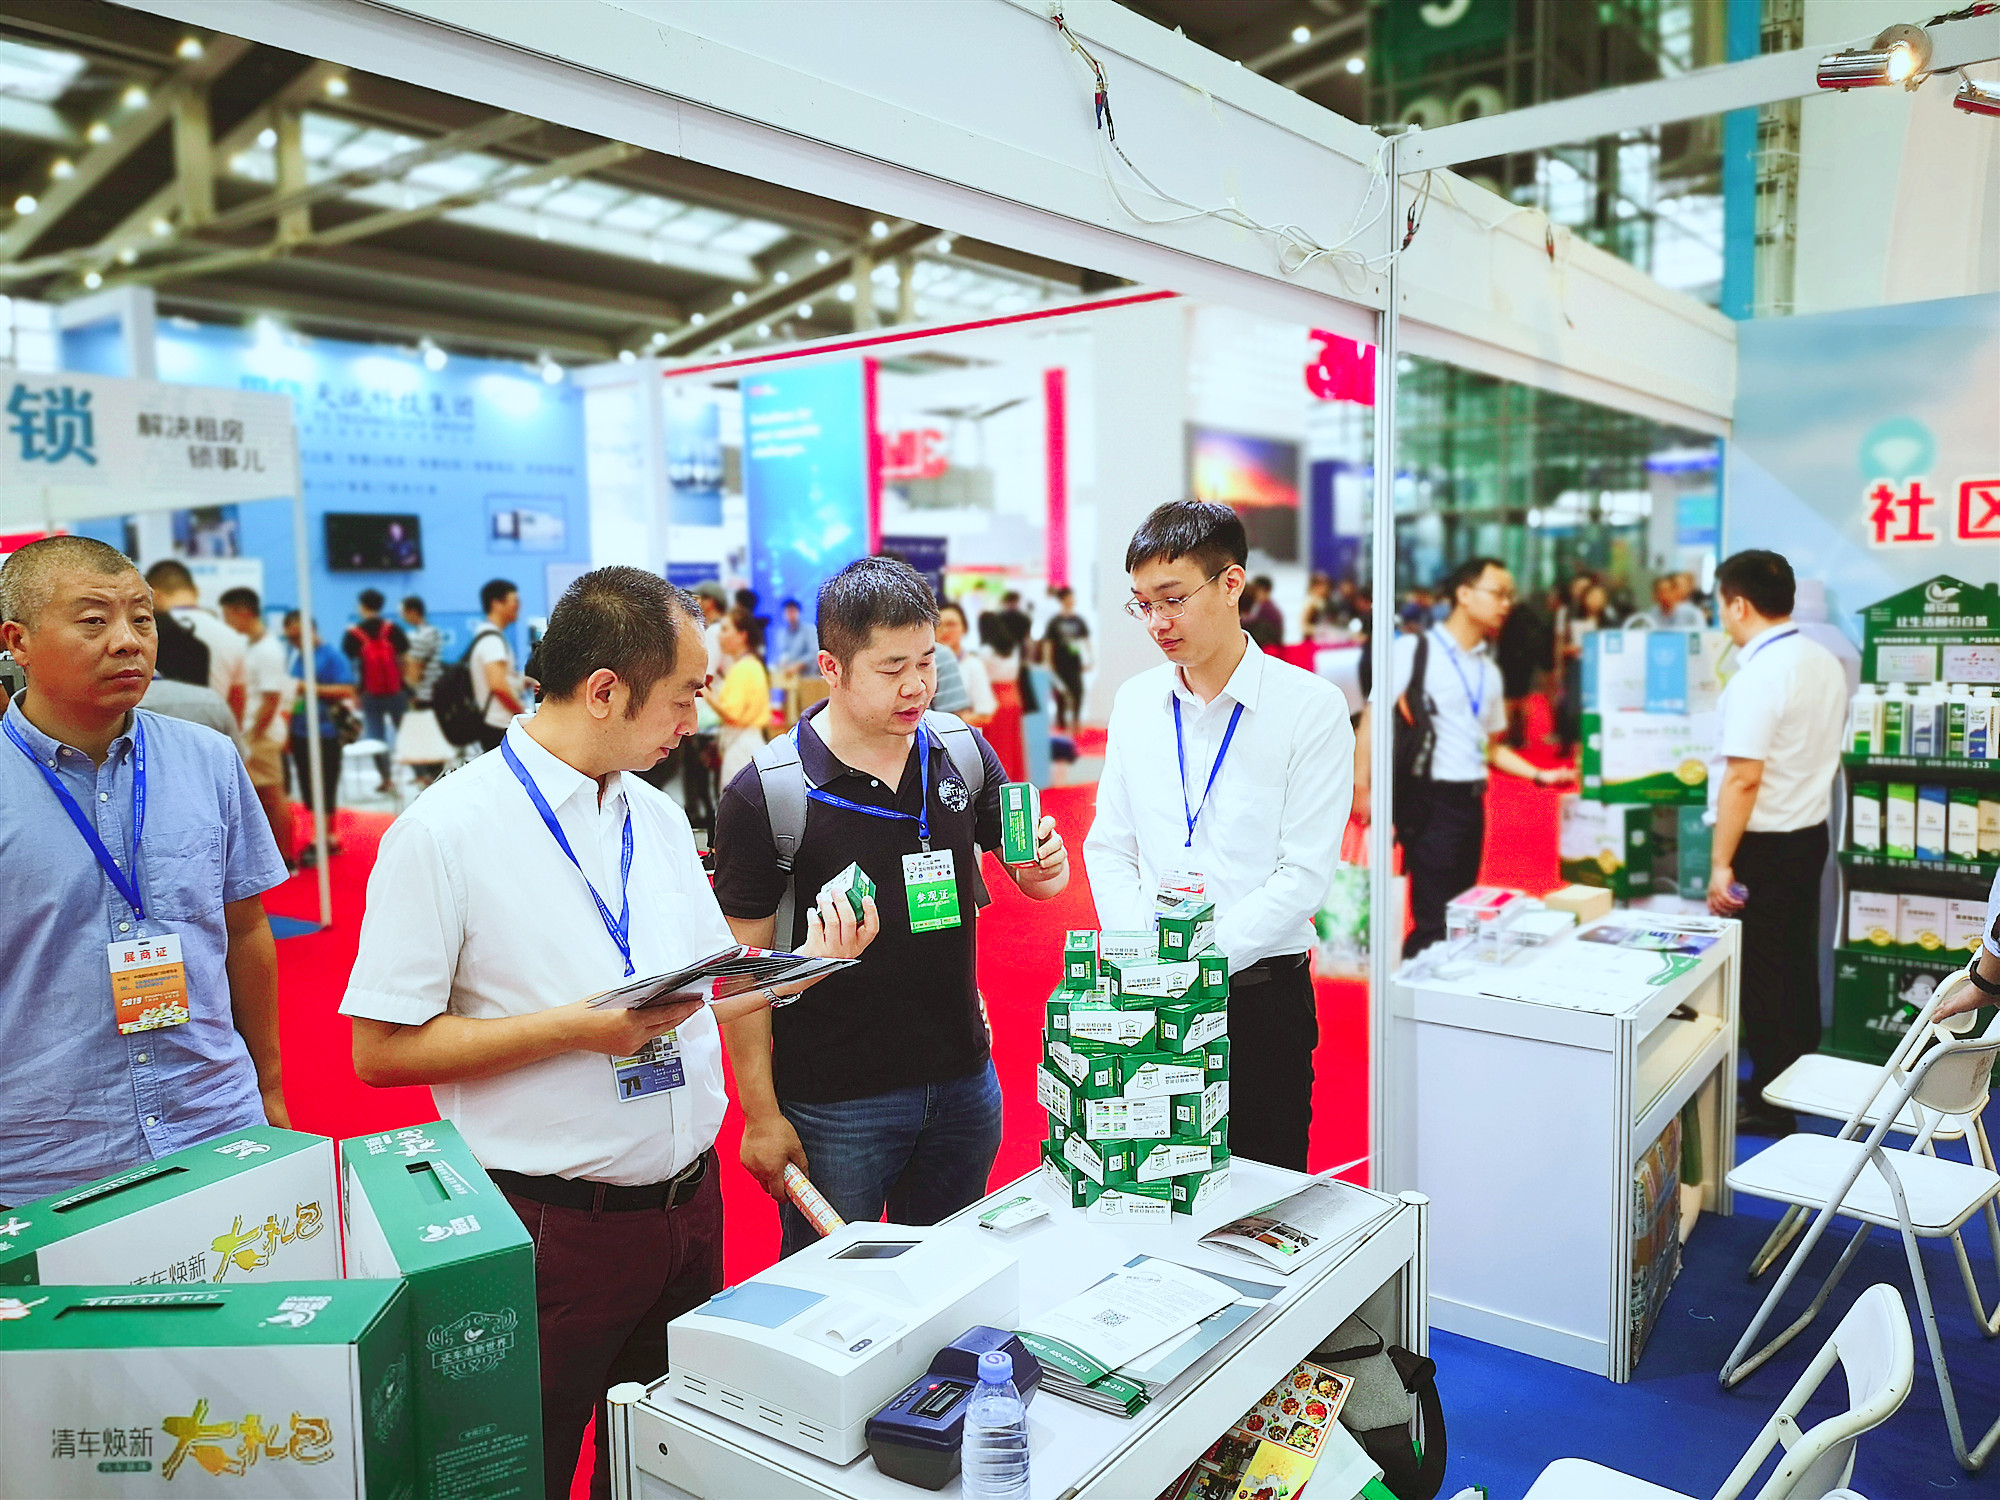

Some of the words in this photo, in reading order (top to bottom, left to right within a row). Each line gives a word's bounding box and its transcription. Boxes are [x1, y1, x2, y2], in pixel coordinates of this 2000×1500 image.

[6, 383, 97, 466] 锁
[137, 412, 244, 444] 解决租房
[189, 445, 265, 473] 锁事儿
[916, 888, 950, 904] 参观证
[123, 946, 168, 963] 展商证
[121, 996, 143, 1007] 2019
[440, 1337, 508, 1364] 还车清新世界
[51, 1426, 154, 1460] 清车焕新
[160, 1396, 335, 1480] 大礼包
